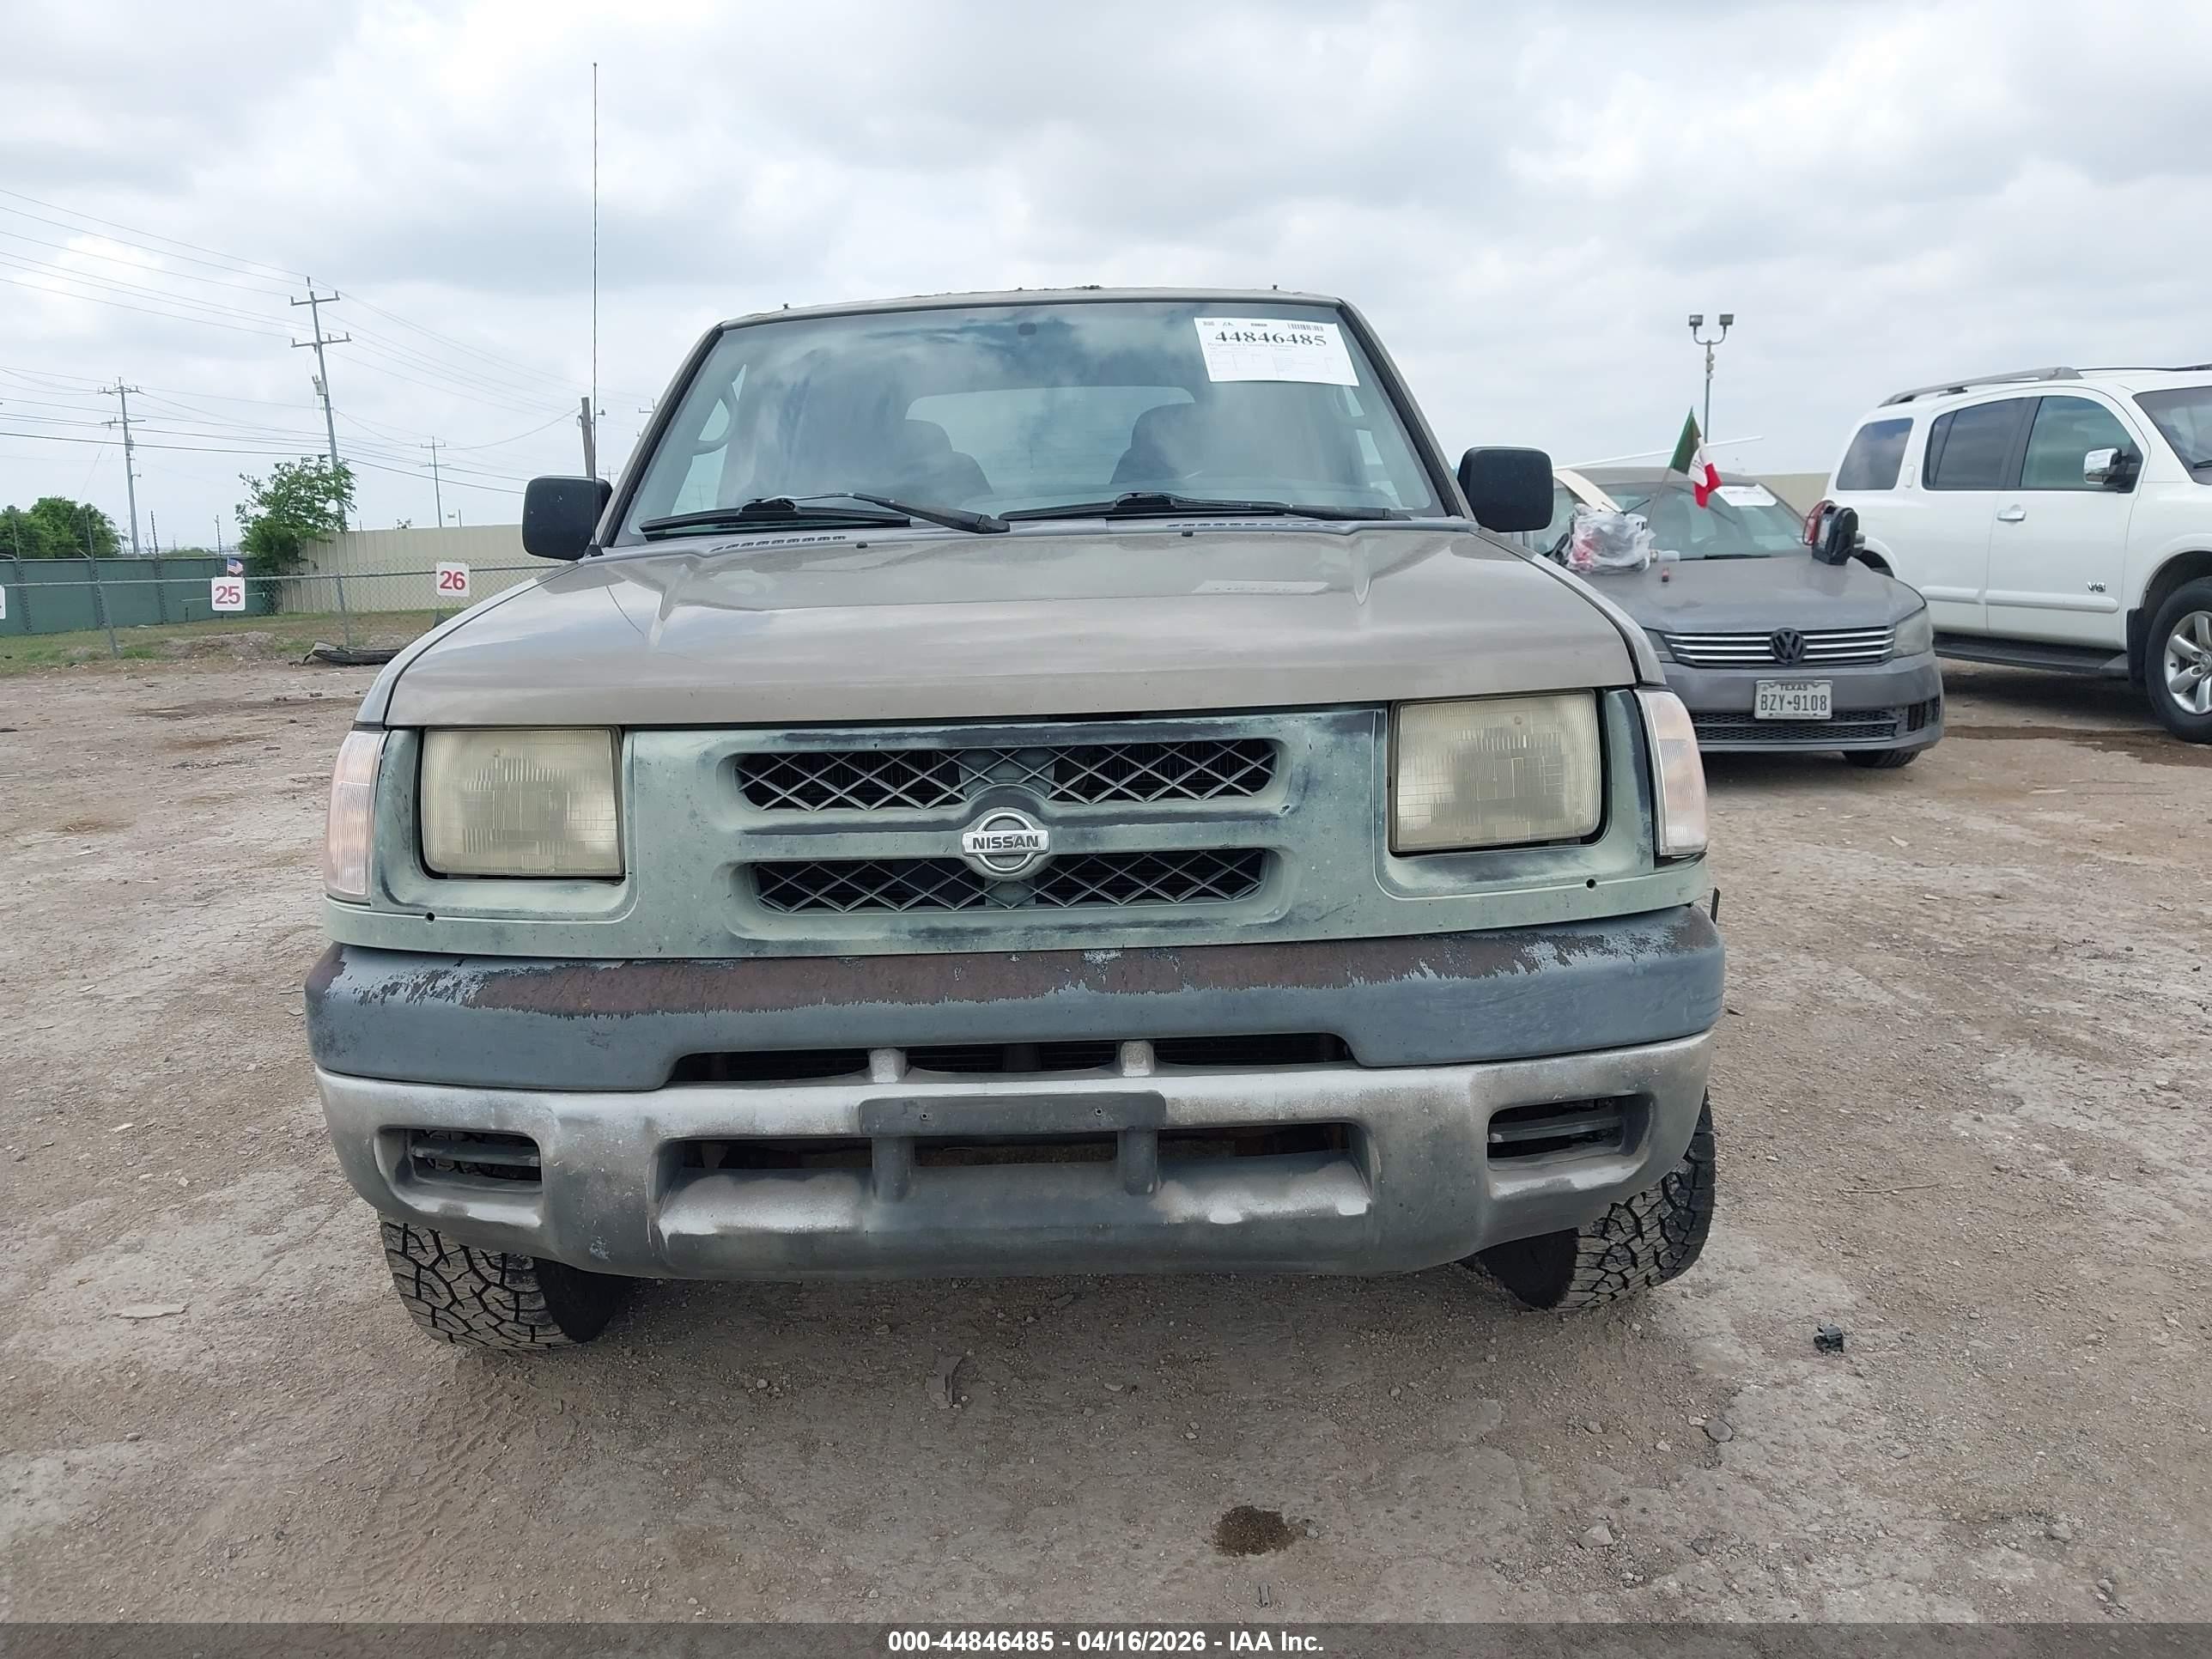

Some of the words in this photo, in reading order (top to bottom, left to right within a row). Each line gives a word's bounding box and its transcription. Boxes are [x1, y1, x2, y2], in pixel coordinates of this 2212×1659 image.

[1215, 331, 1327, 346] 44846485
[440, 570, 466, 591] 26
[215, 586, 240, 605] 25
[1779, 683, 1808, 691] TEXAS
[972, 836, 1038, 849] NISSAN
